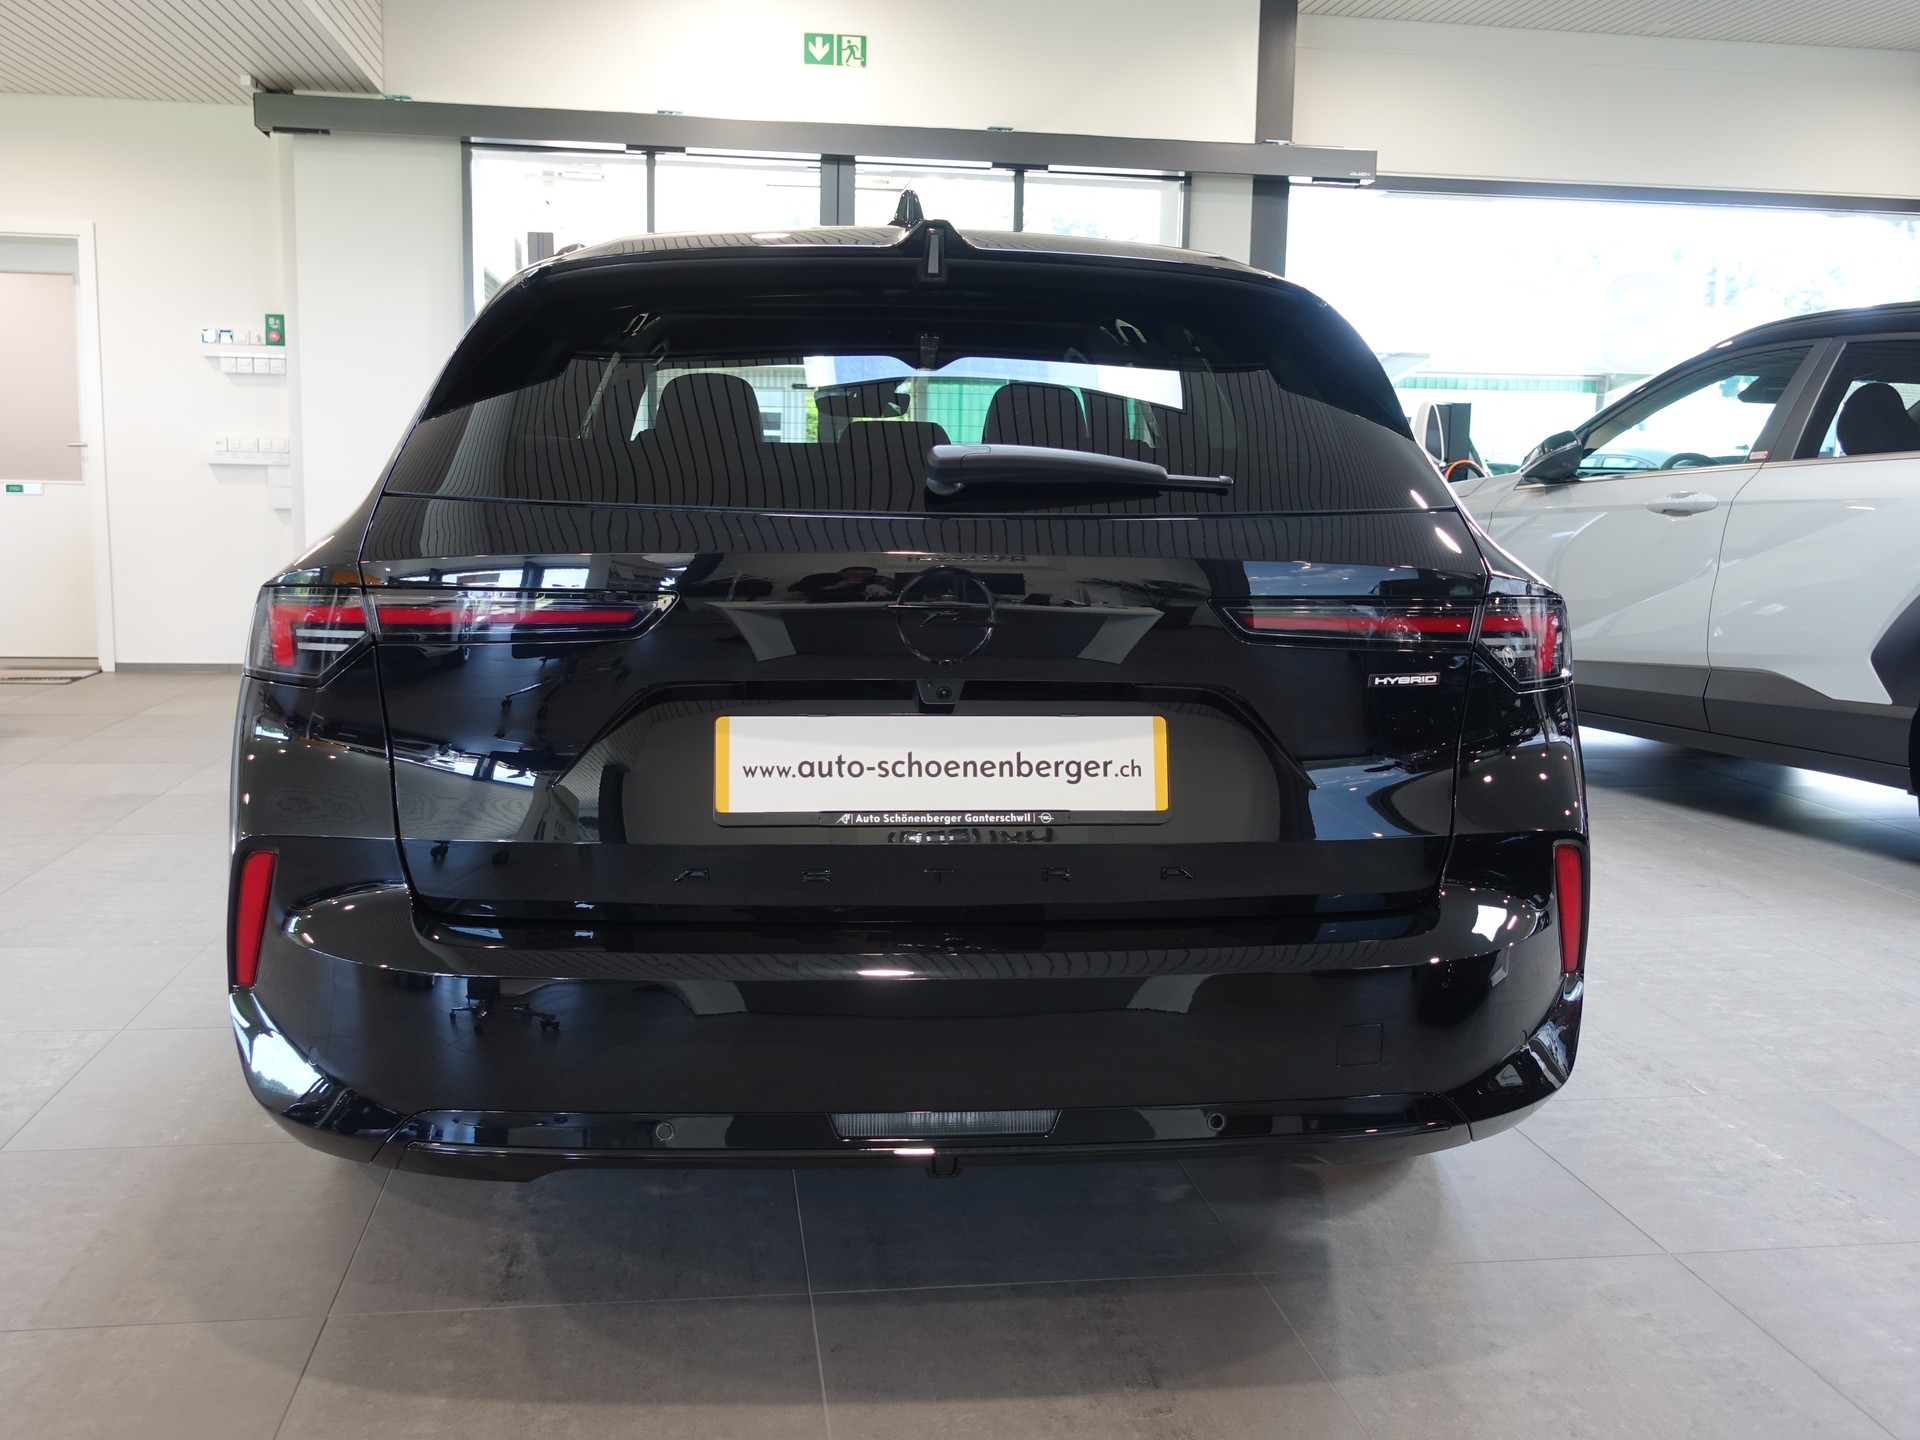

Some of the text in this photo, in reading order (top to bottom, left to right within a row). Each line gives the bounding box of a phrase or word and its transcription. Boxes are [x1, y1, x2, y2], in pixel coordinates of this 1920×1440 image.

[1374, 675, 1438, 685] HYBRID
[742, 751, 1142, 785] www.auto-schoenenberger.ch
[855, 813, 881, 823] Auto
[883, 812, 962, 825] Schönenberger
[964, 812, 1031, 823] Ganterschwil
[674, 866, 1195, 883] ASTRA
